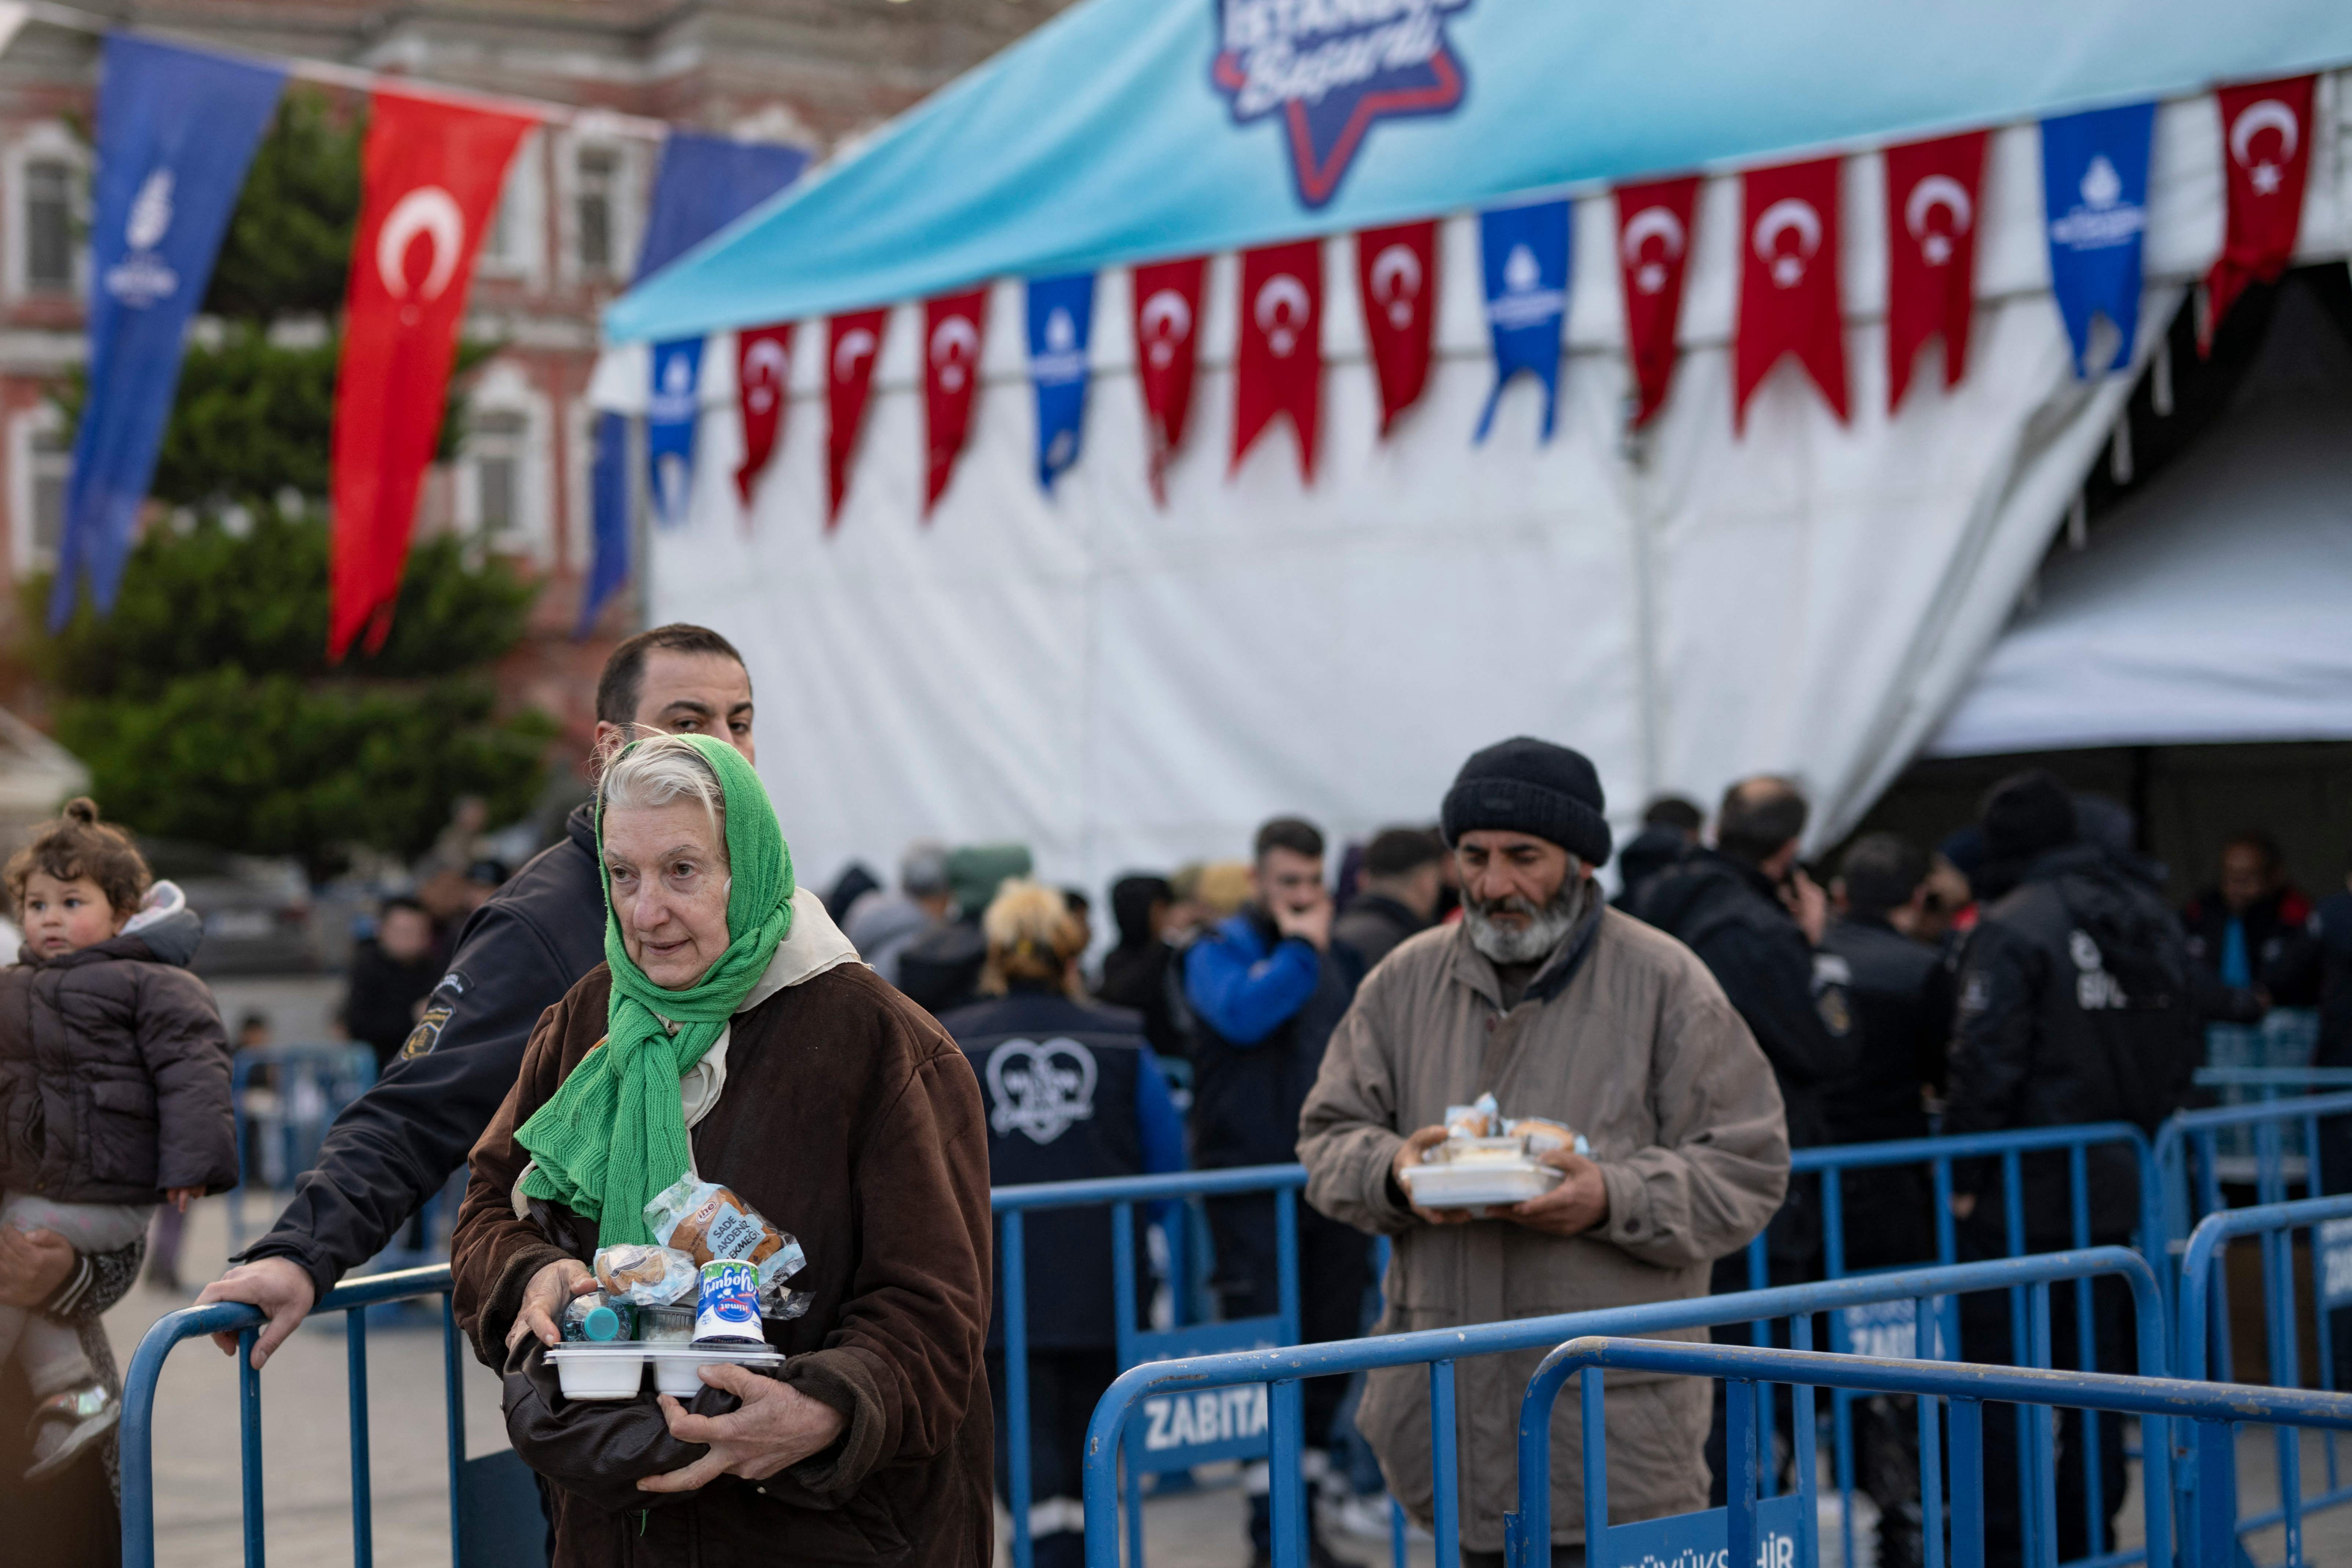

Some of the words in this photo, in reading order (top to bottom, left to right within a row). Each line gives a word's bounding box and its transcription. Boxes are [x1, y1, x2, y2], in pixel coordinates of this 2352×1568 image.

[713, 1215, 737, 1239] SADE
[717, 1220, 750, 1253] AKDENİZ
[704, 1268, 754, 1298] Yogurt
[1144, 1384, 1268, 1451] ZABITA
